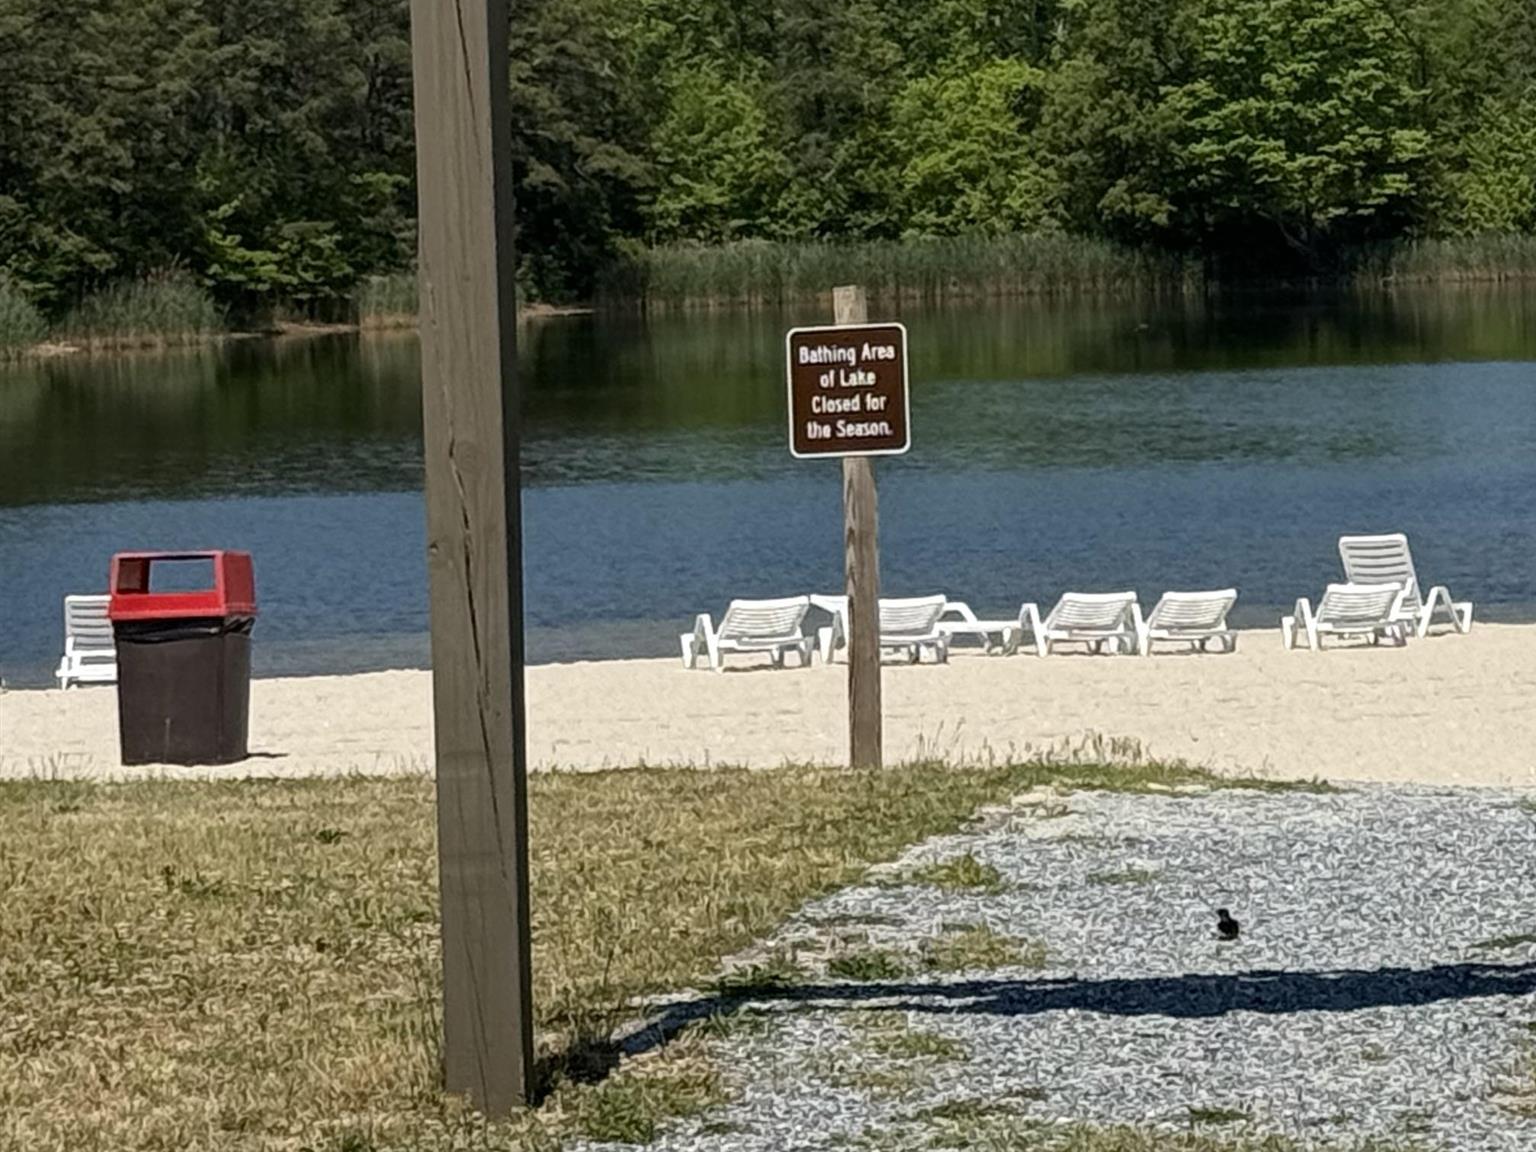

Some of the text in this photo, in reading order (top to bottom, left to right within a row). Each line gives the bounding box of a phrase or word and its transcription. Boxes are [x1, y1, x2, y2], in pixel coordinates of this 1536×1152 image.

[799, 342, 895, 366] Bathing Area
[820, 369, 876, 388] of Lake
[811, 393, 887, 414] Closed for
[806, 421, 832, 439] the
